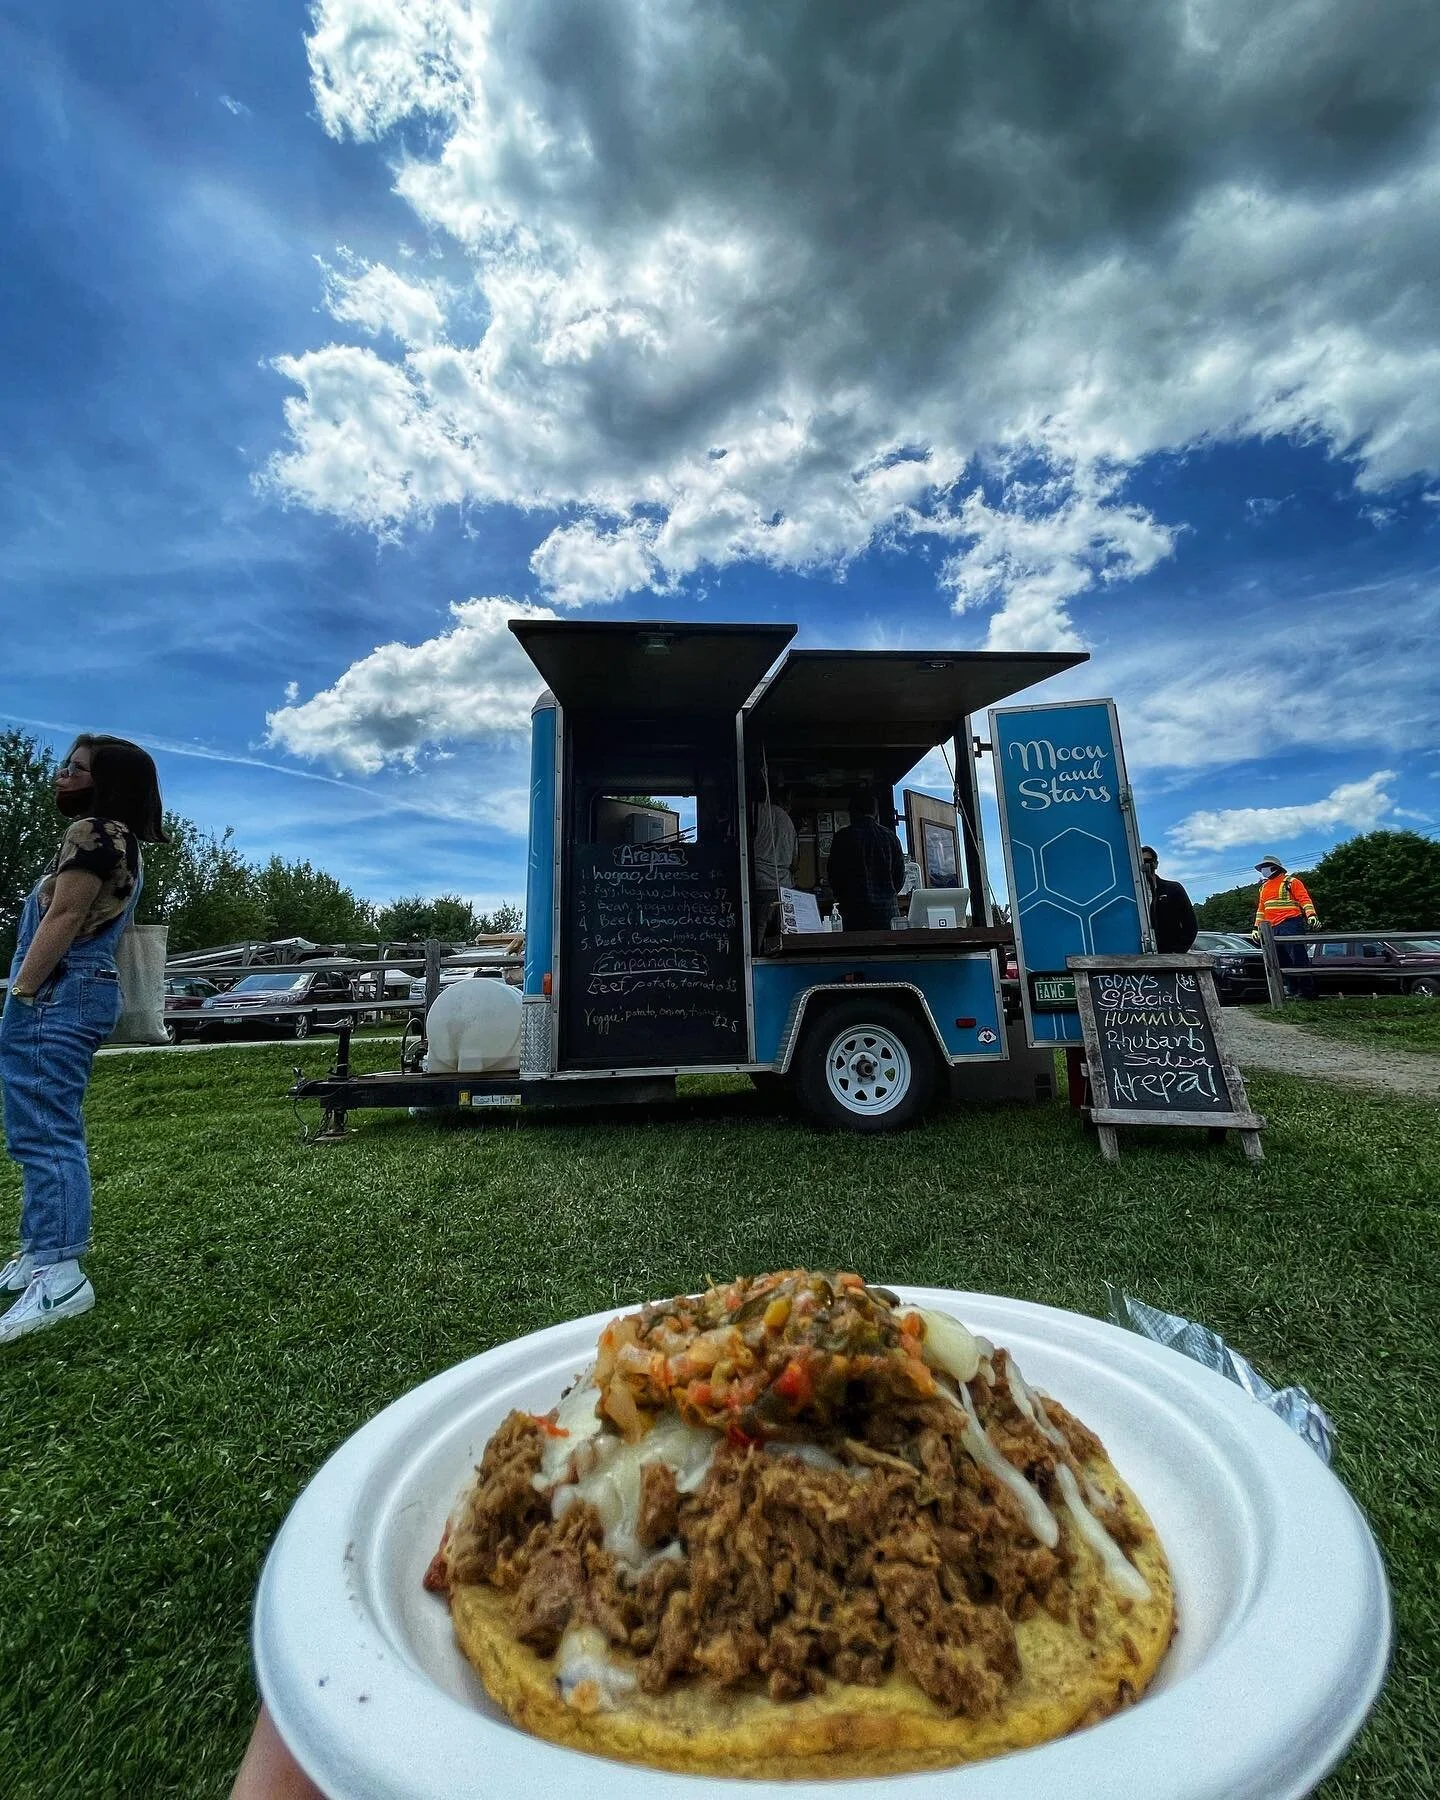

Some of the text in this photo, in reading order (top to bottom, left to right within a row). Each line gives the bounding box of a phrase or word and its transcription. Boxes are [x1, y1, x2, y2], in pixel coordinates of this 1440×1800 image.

[1009, 740, 1109, 771] Moon
[1059, 760, 1103, 781] and
[1018, 777, 1111, 810] Stars
[620, 845, 681, 873] Arepas
[598, 951, 701, 975] Empanadas
[1105, 1027, 1205, 1053] Rhubarb
[1123, 1050, 1215, 1068] Salsa
[1112, 1067, 1220, 1104] Arepa!
